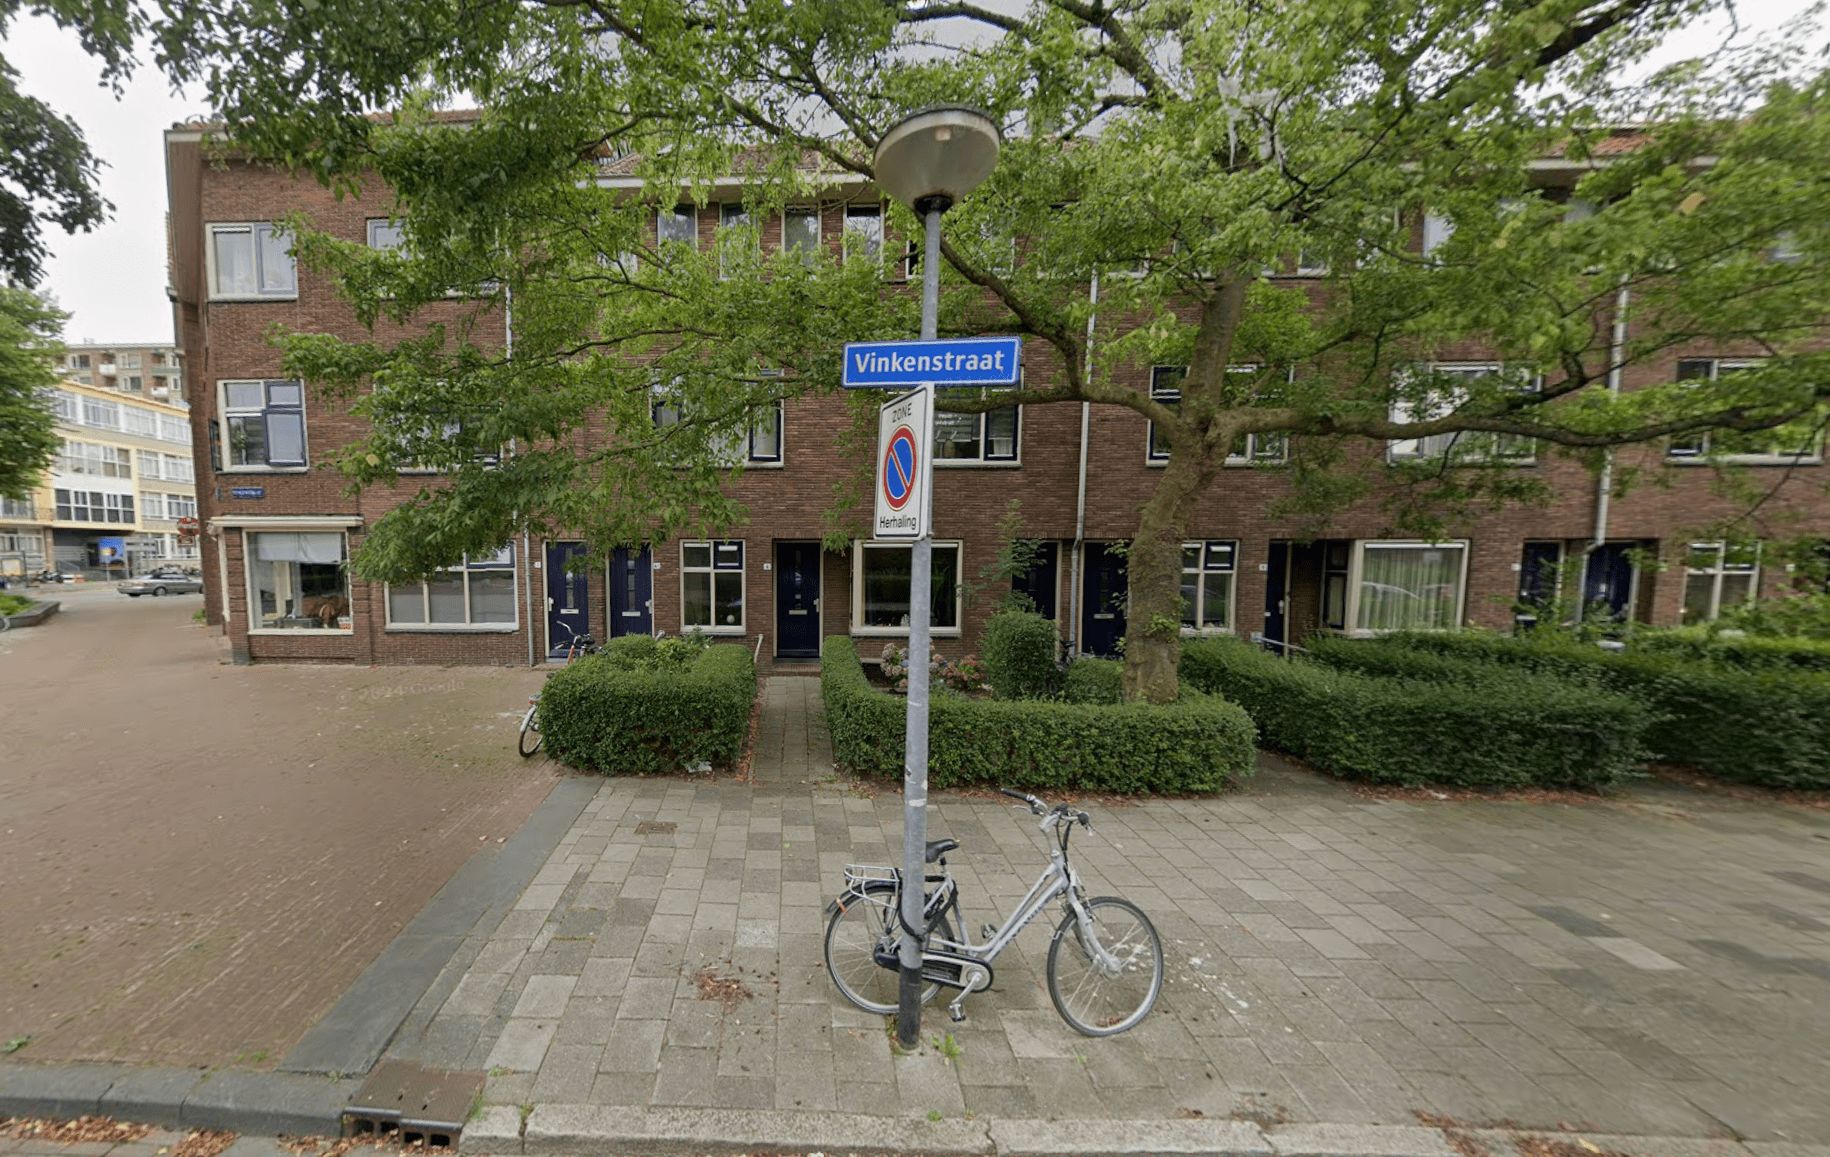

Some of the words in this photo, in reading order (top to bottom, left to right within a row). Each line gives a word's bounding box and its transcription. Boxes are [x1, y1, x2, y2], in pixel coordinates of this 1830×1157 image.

[855, 350, 1005, 373] Vinkenstraat
[892, 403, 912, 423] ZONE
[879, 516, 917, 530] Herhaling
